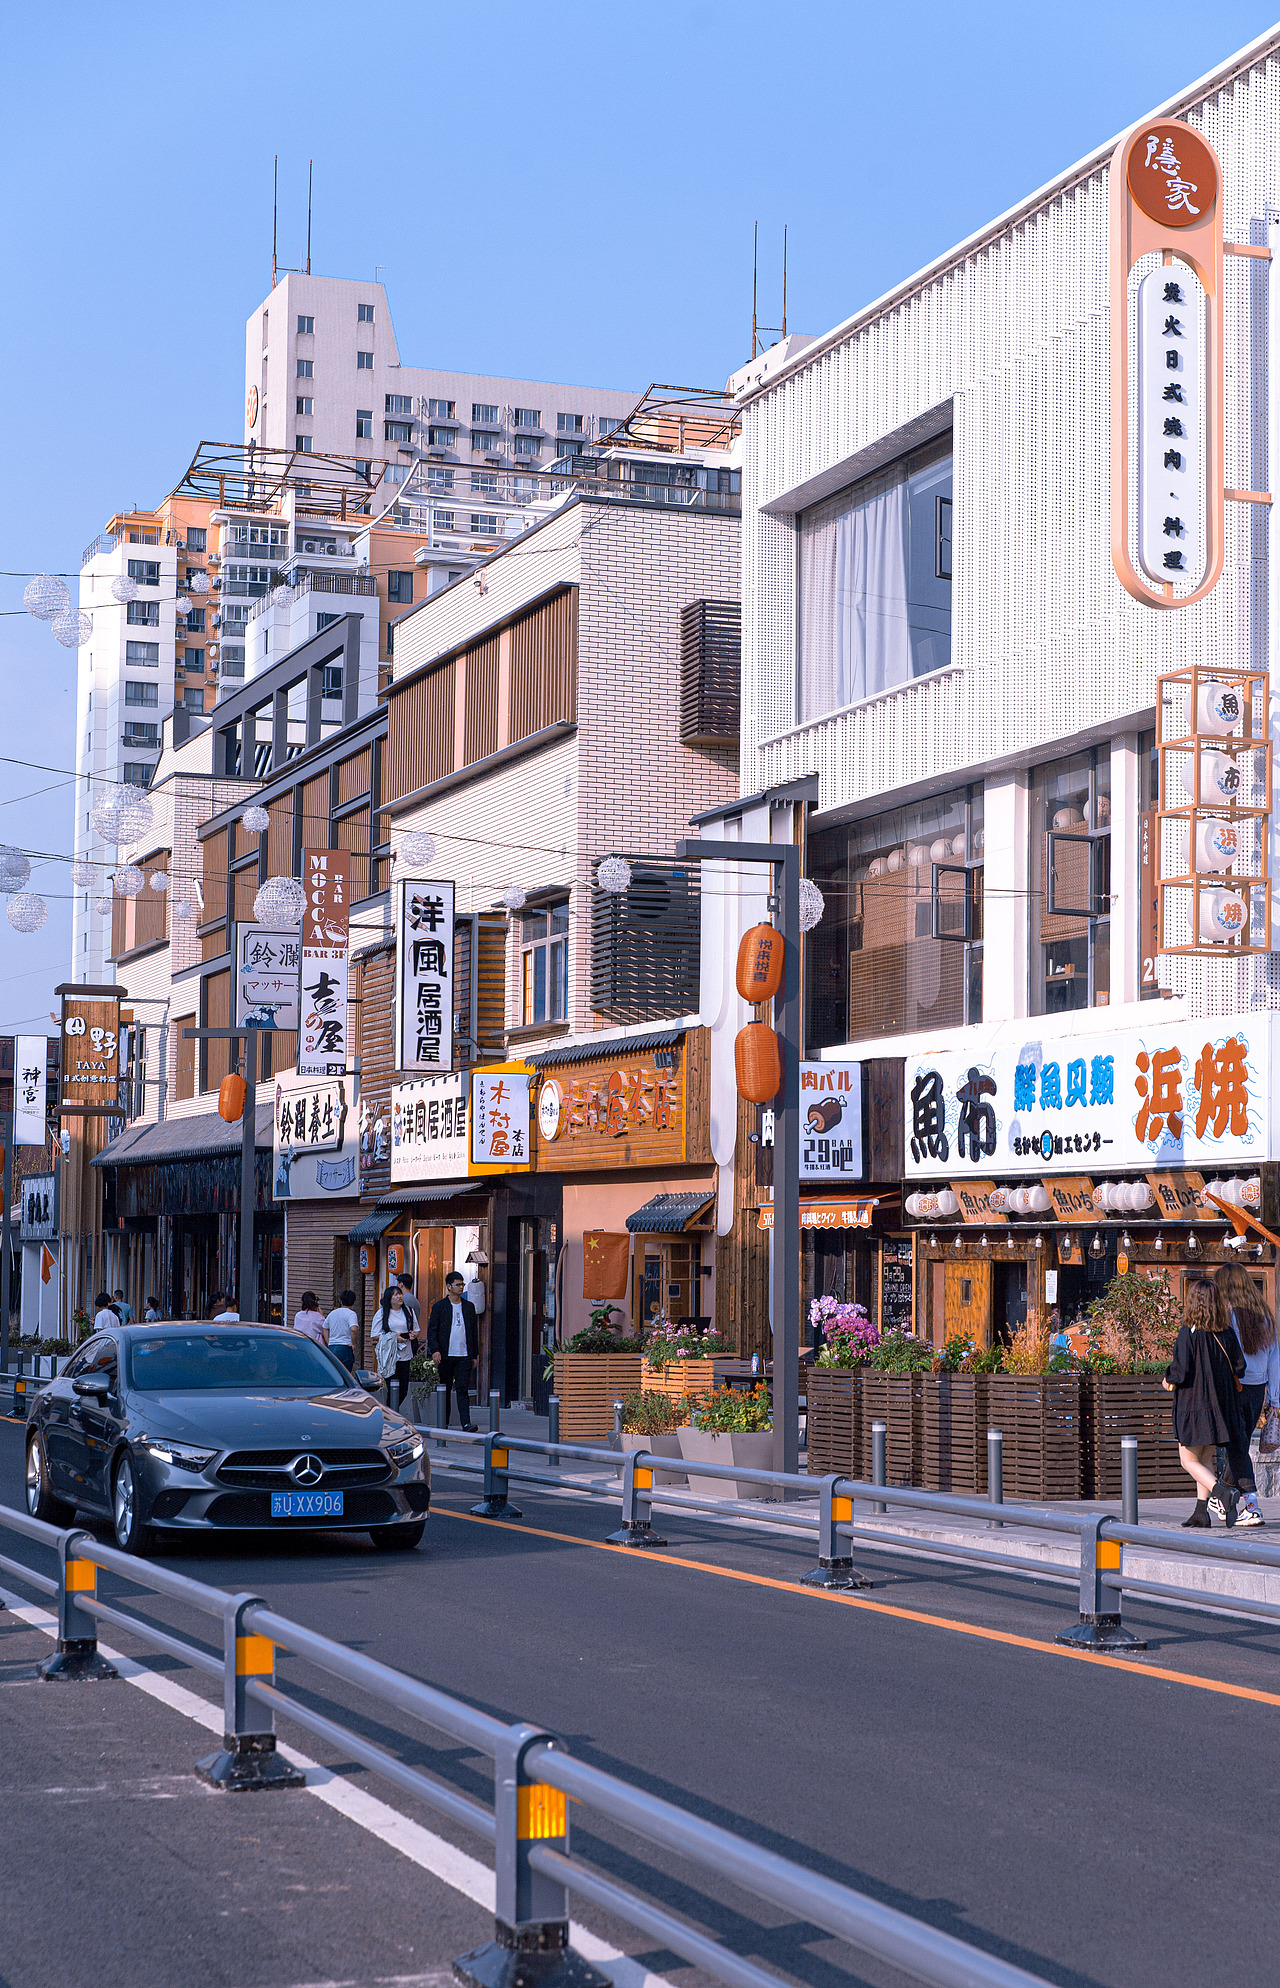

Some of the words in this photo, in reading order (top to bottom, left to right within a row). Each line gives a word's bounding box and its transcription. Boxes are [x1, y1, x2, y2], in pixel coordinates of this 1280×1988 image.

[1224, 766, 1240, 789] 市
[309, 855, 328, 939] MOCCA
[333, 874, 344, 903] BAR
[303, 949, 328, 959] BAR
[331, 950, 346, 960] 3F
[247, 980, 299, 993] マッサー
[410, 895, 448, 1063] 洋風居酒屋
[65, 1016, 118, 1060] 田野
[76, 1060, 106, 1070] TAYA
[801, 1069, 853, 1092] 肉バル
[1135, 1036, 1249, 1143] 浜焼
[402, 1096, 466, 1145] 洋風居酒屋
[489, 1080, 511, 1157] 木村屋
[911, 1066, 997, 1163] 魚市
